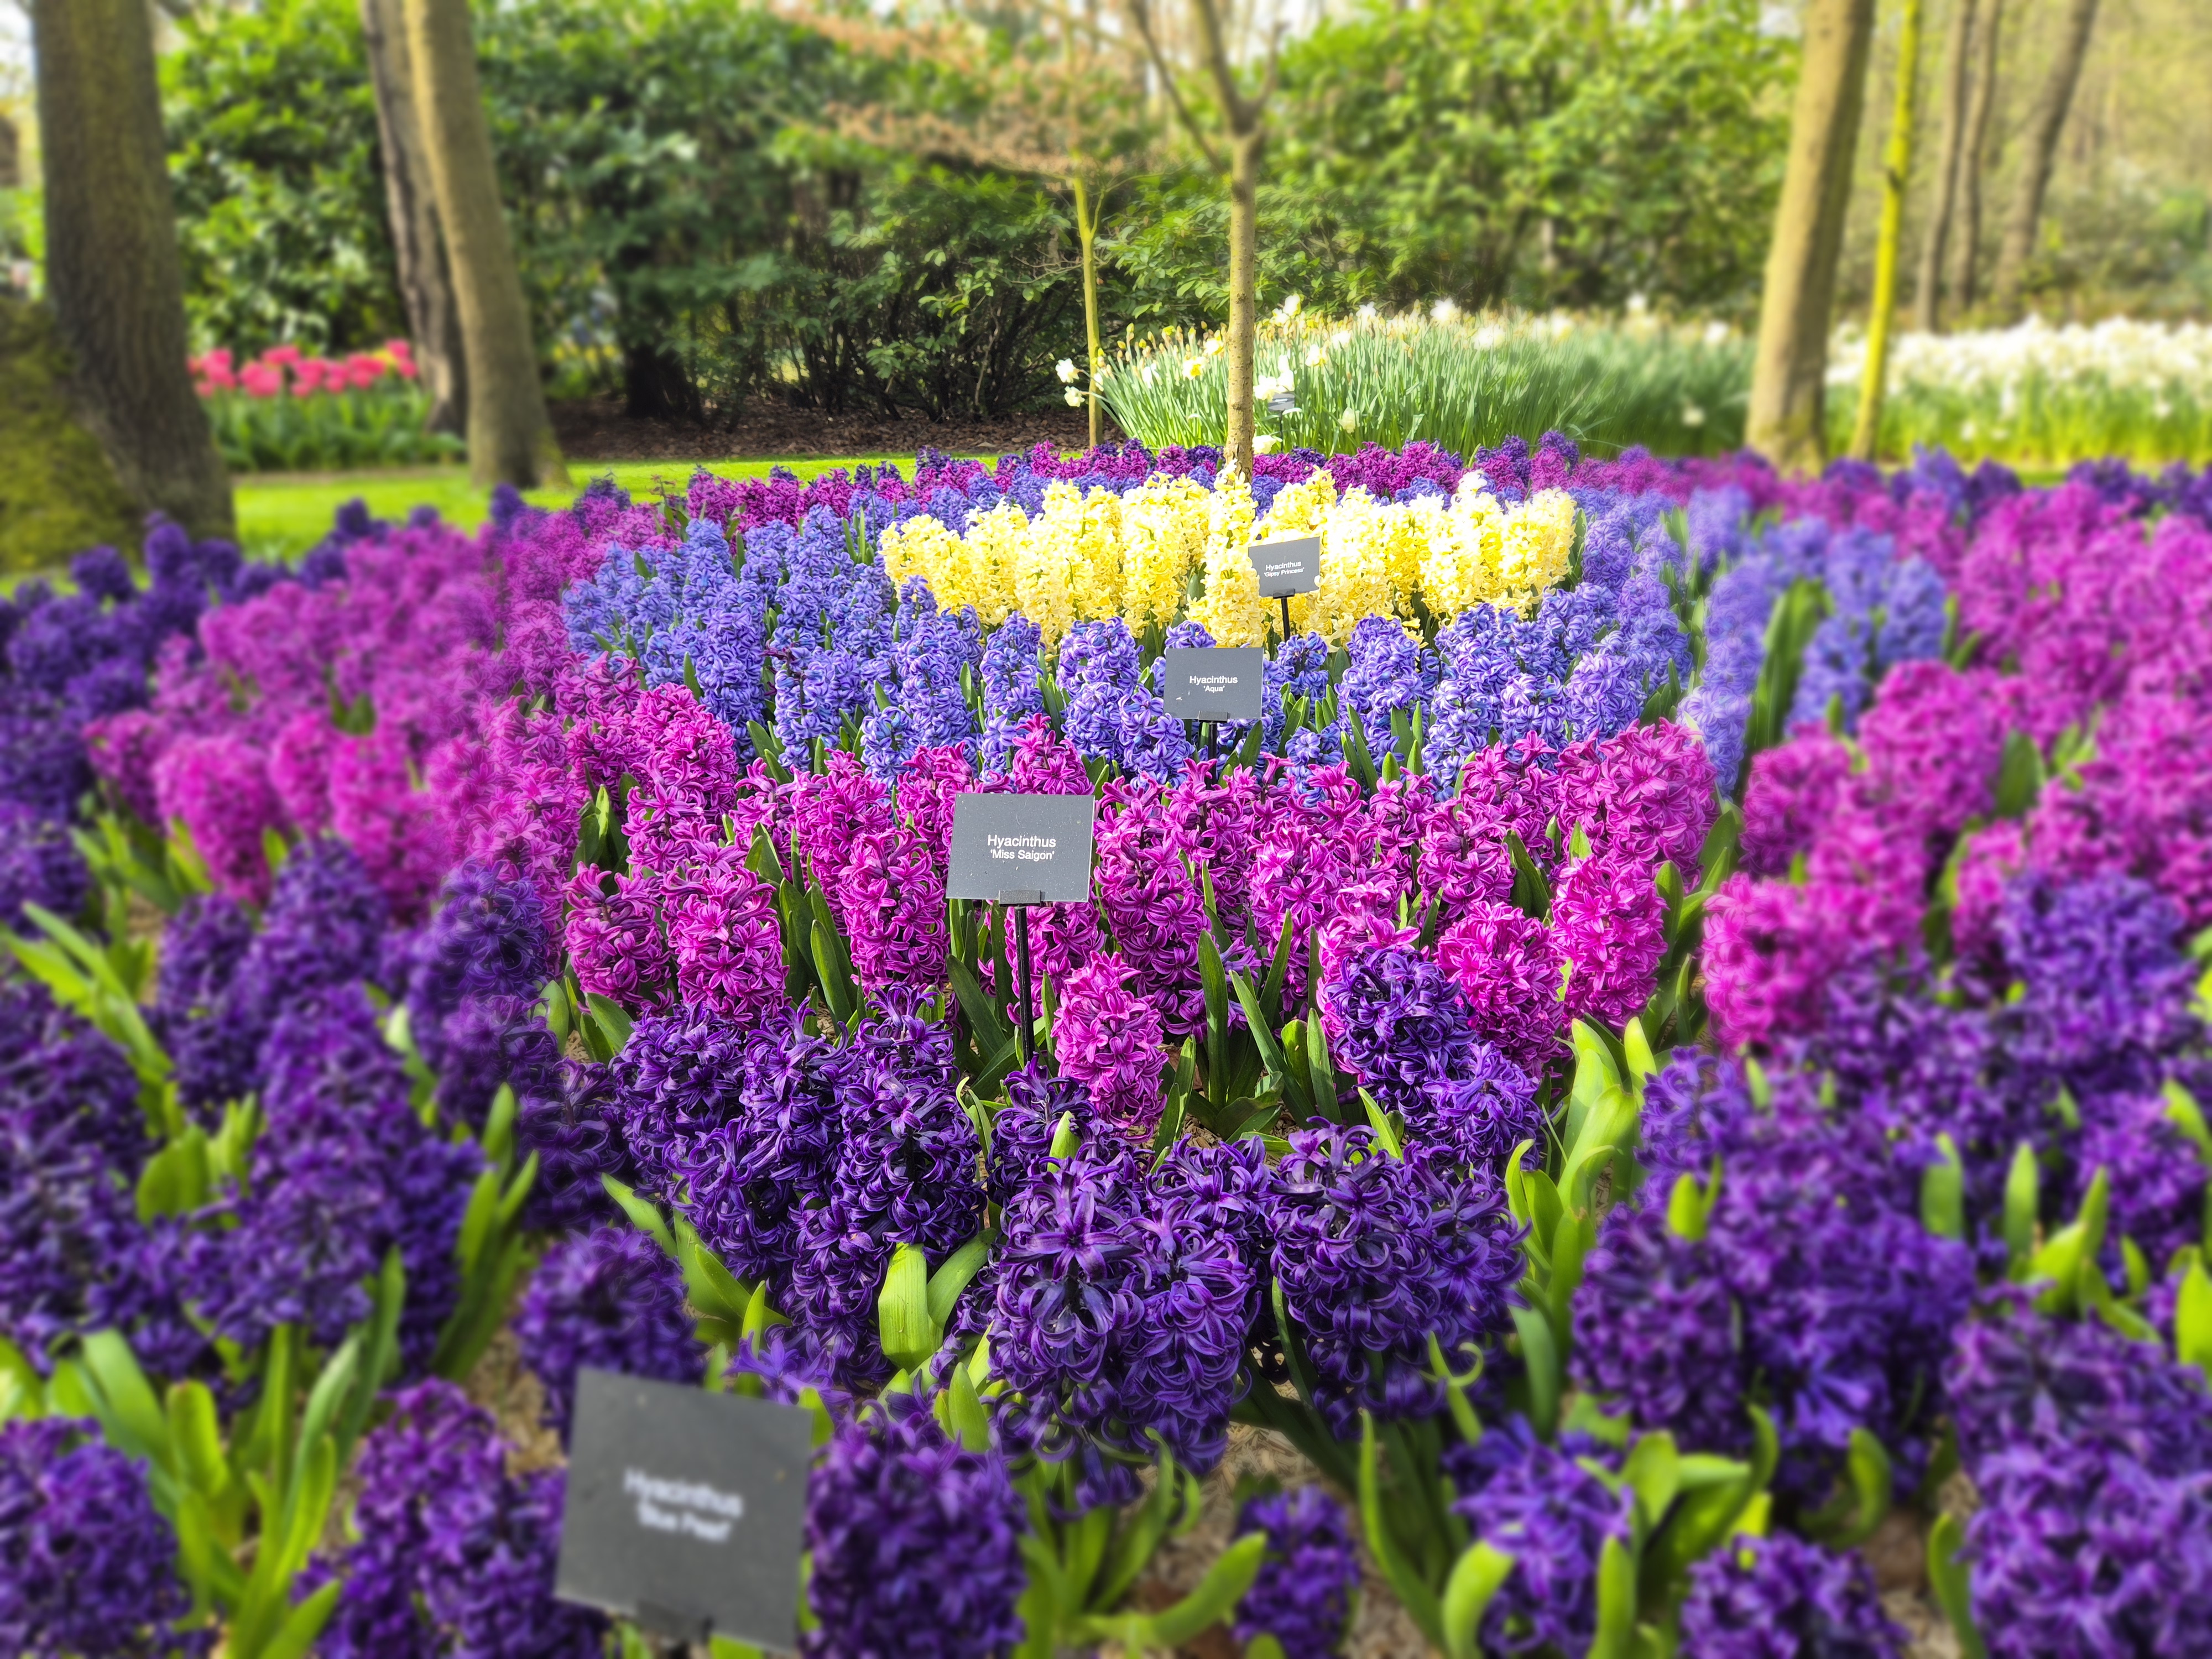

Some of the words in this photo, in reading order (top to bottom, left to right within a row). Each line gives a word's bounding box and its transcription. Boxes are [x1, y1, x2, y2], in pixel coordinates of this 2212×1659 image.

[1265, 561, 1302, 571] Hyacinthus
[1189, 675, 1238, 685] Hyacinthus
[987, 834, 1056, 848] Hyacinthus
[990, 849, 1015, 859] 'Miss
[1018, 849, 1055, 862] Saigon'
